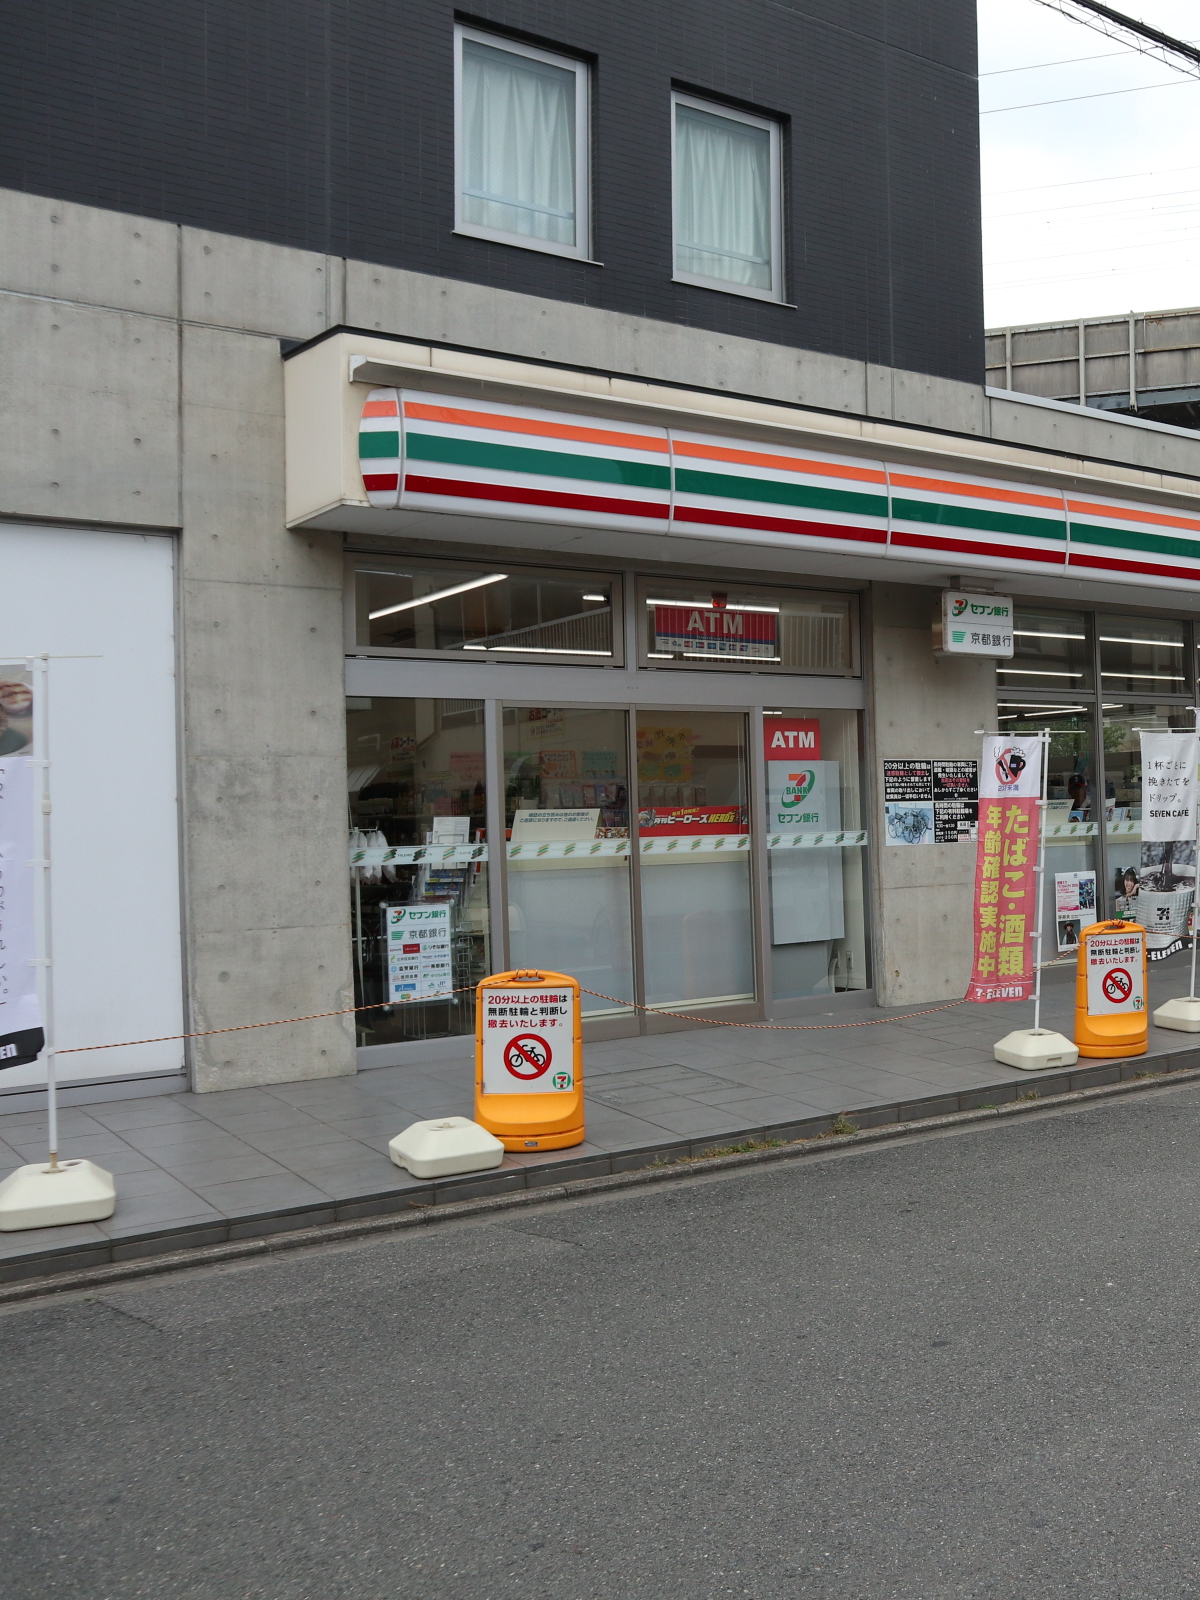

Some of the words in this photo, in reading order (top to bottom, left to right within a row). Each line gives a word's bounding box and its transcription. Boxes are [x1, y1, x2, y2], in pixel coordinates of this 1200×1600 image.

[970, 603, 1009, 617] セブン銀行
[687, 610, 743, 635] ATM
[970, 632, 1011, 648] 京都銀行
[771, 730, 815, 748] ATM
[1147, 760, 1187, 770] 1杯ごとに
[1148, 776, 1190, 787] 挽きたてを
[786, 786, 808, 795] BANK
[777, 812, 819, 824] セブン銀行
[1149, 810, 1171, 818] SEVEN
[1172, 807, 1189, 817] CAFÉ
[654, 814, 709, 824] 月刊ヒーローズ
[977, 804, 1003, 978] 年齢確認実施中
[998, 804, 1029, 977] たばこ・酒類
[408, 909, 447, 920] セブン銀行
[408, 928, 447, 940] 京都銀行
[1090, 938, 1140, 948] 20分以上の駐輪は
[1090, 947, 1140, 957] 無断駐輪と判断し
[1146, 940, 1183, 961] -ELEVEN
[1090, 956, 1138, 966] 撤去いたします。
[488, 994, 568, 1005] 20分以上の駐輪は
[488, 1006, 568, 1017] 無断駐輪と判断し
[488, 1018, 563, 1029] 撤去いたします。
